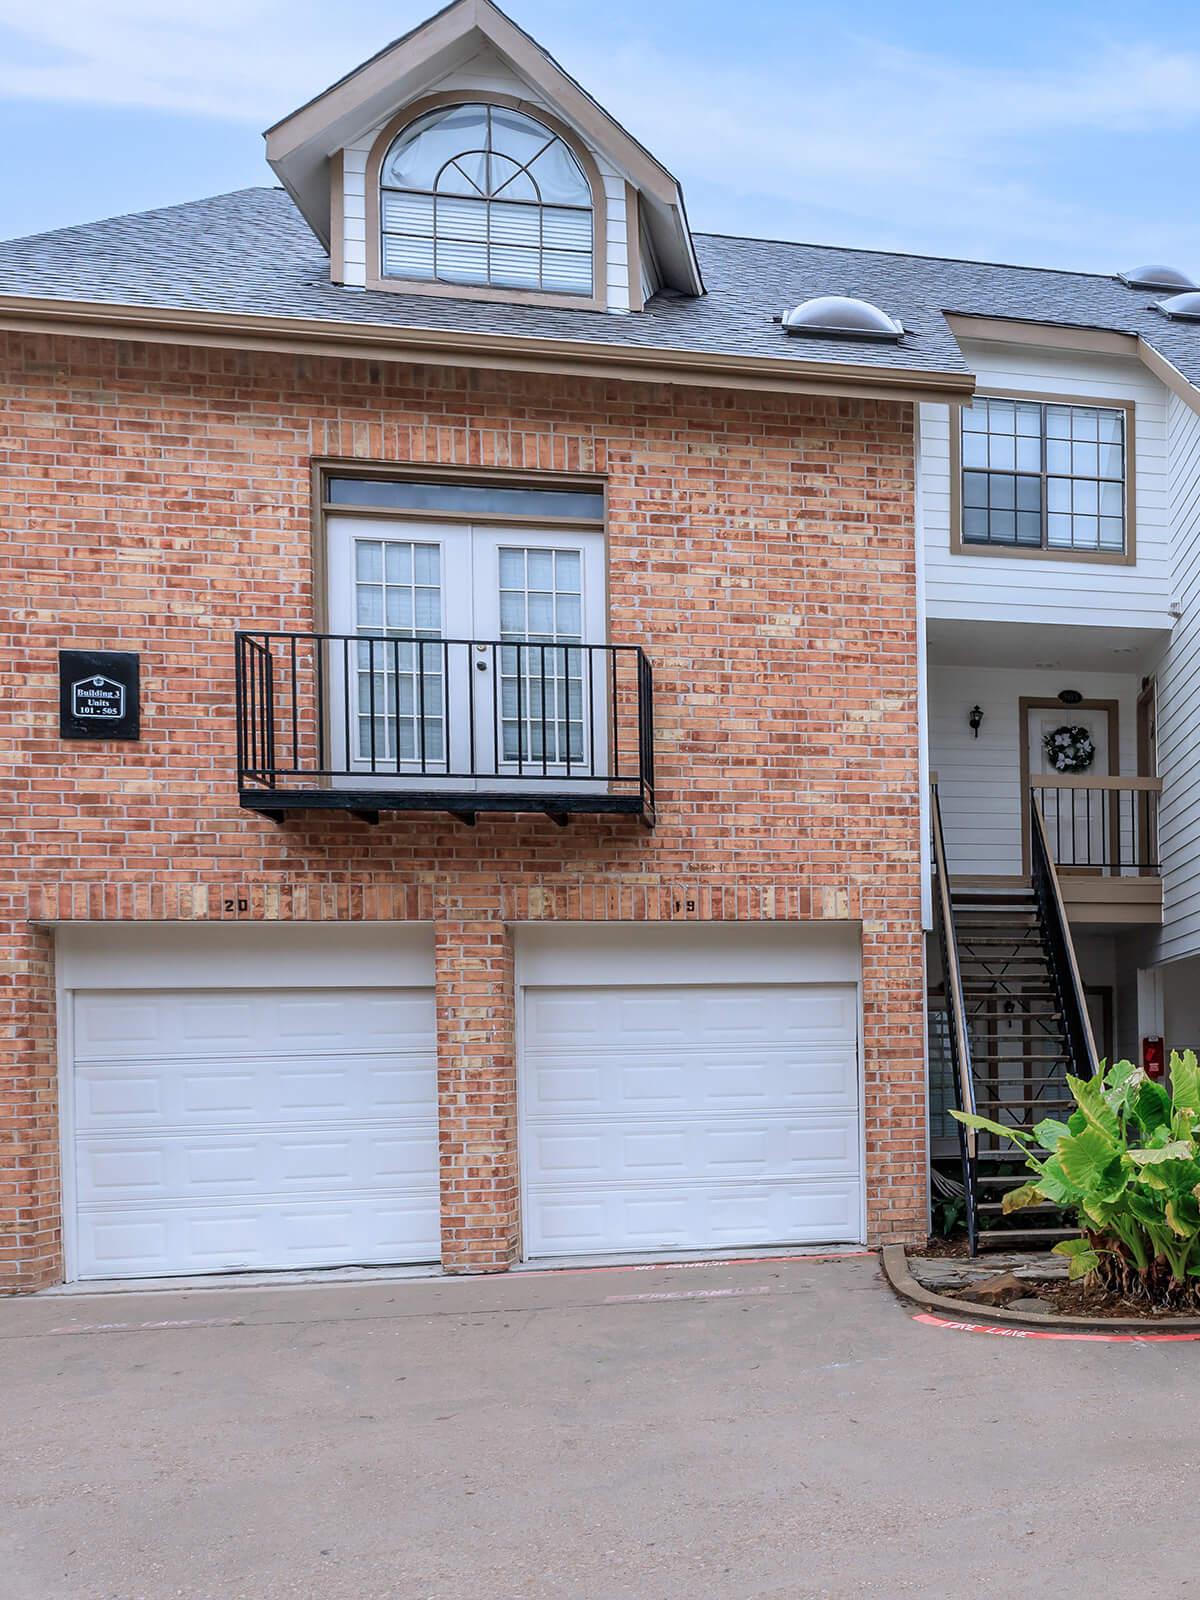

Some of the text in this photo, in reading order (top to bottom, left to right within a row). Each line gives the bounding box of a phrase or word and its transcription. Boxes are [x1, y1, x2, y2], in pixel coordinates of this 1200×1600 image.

[77, 688, 113, 698] Building
[87, 699, 110, 707] Units
[80, 706, 94, 714] 101
[102, 707, 118, 715] 505
[224, 899, 248, 912] 20
[675, 900, 696, 912] 19
[985, 1327, 1035, 1338] LANE
